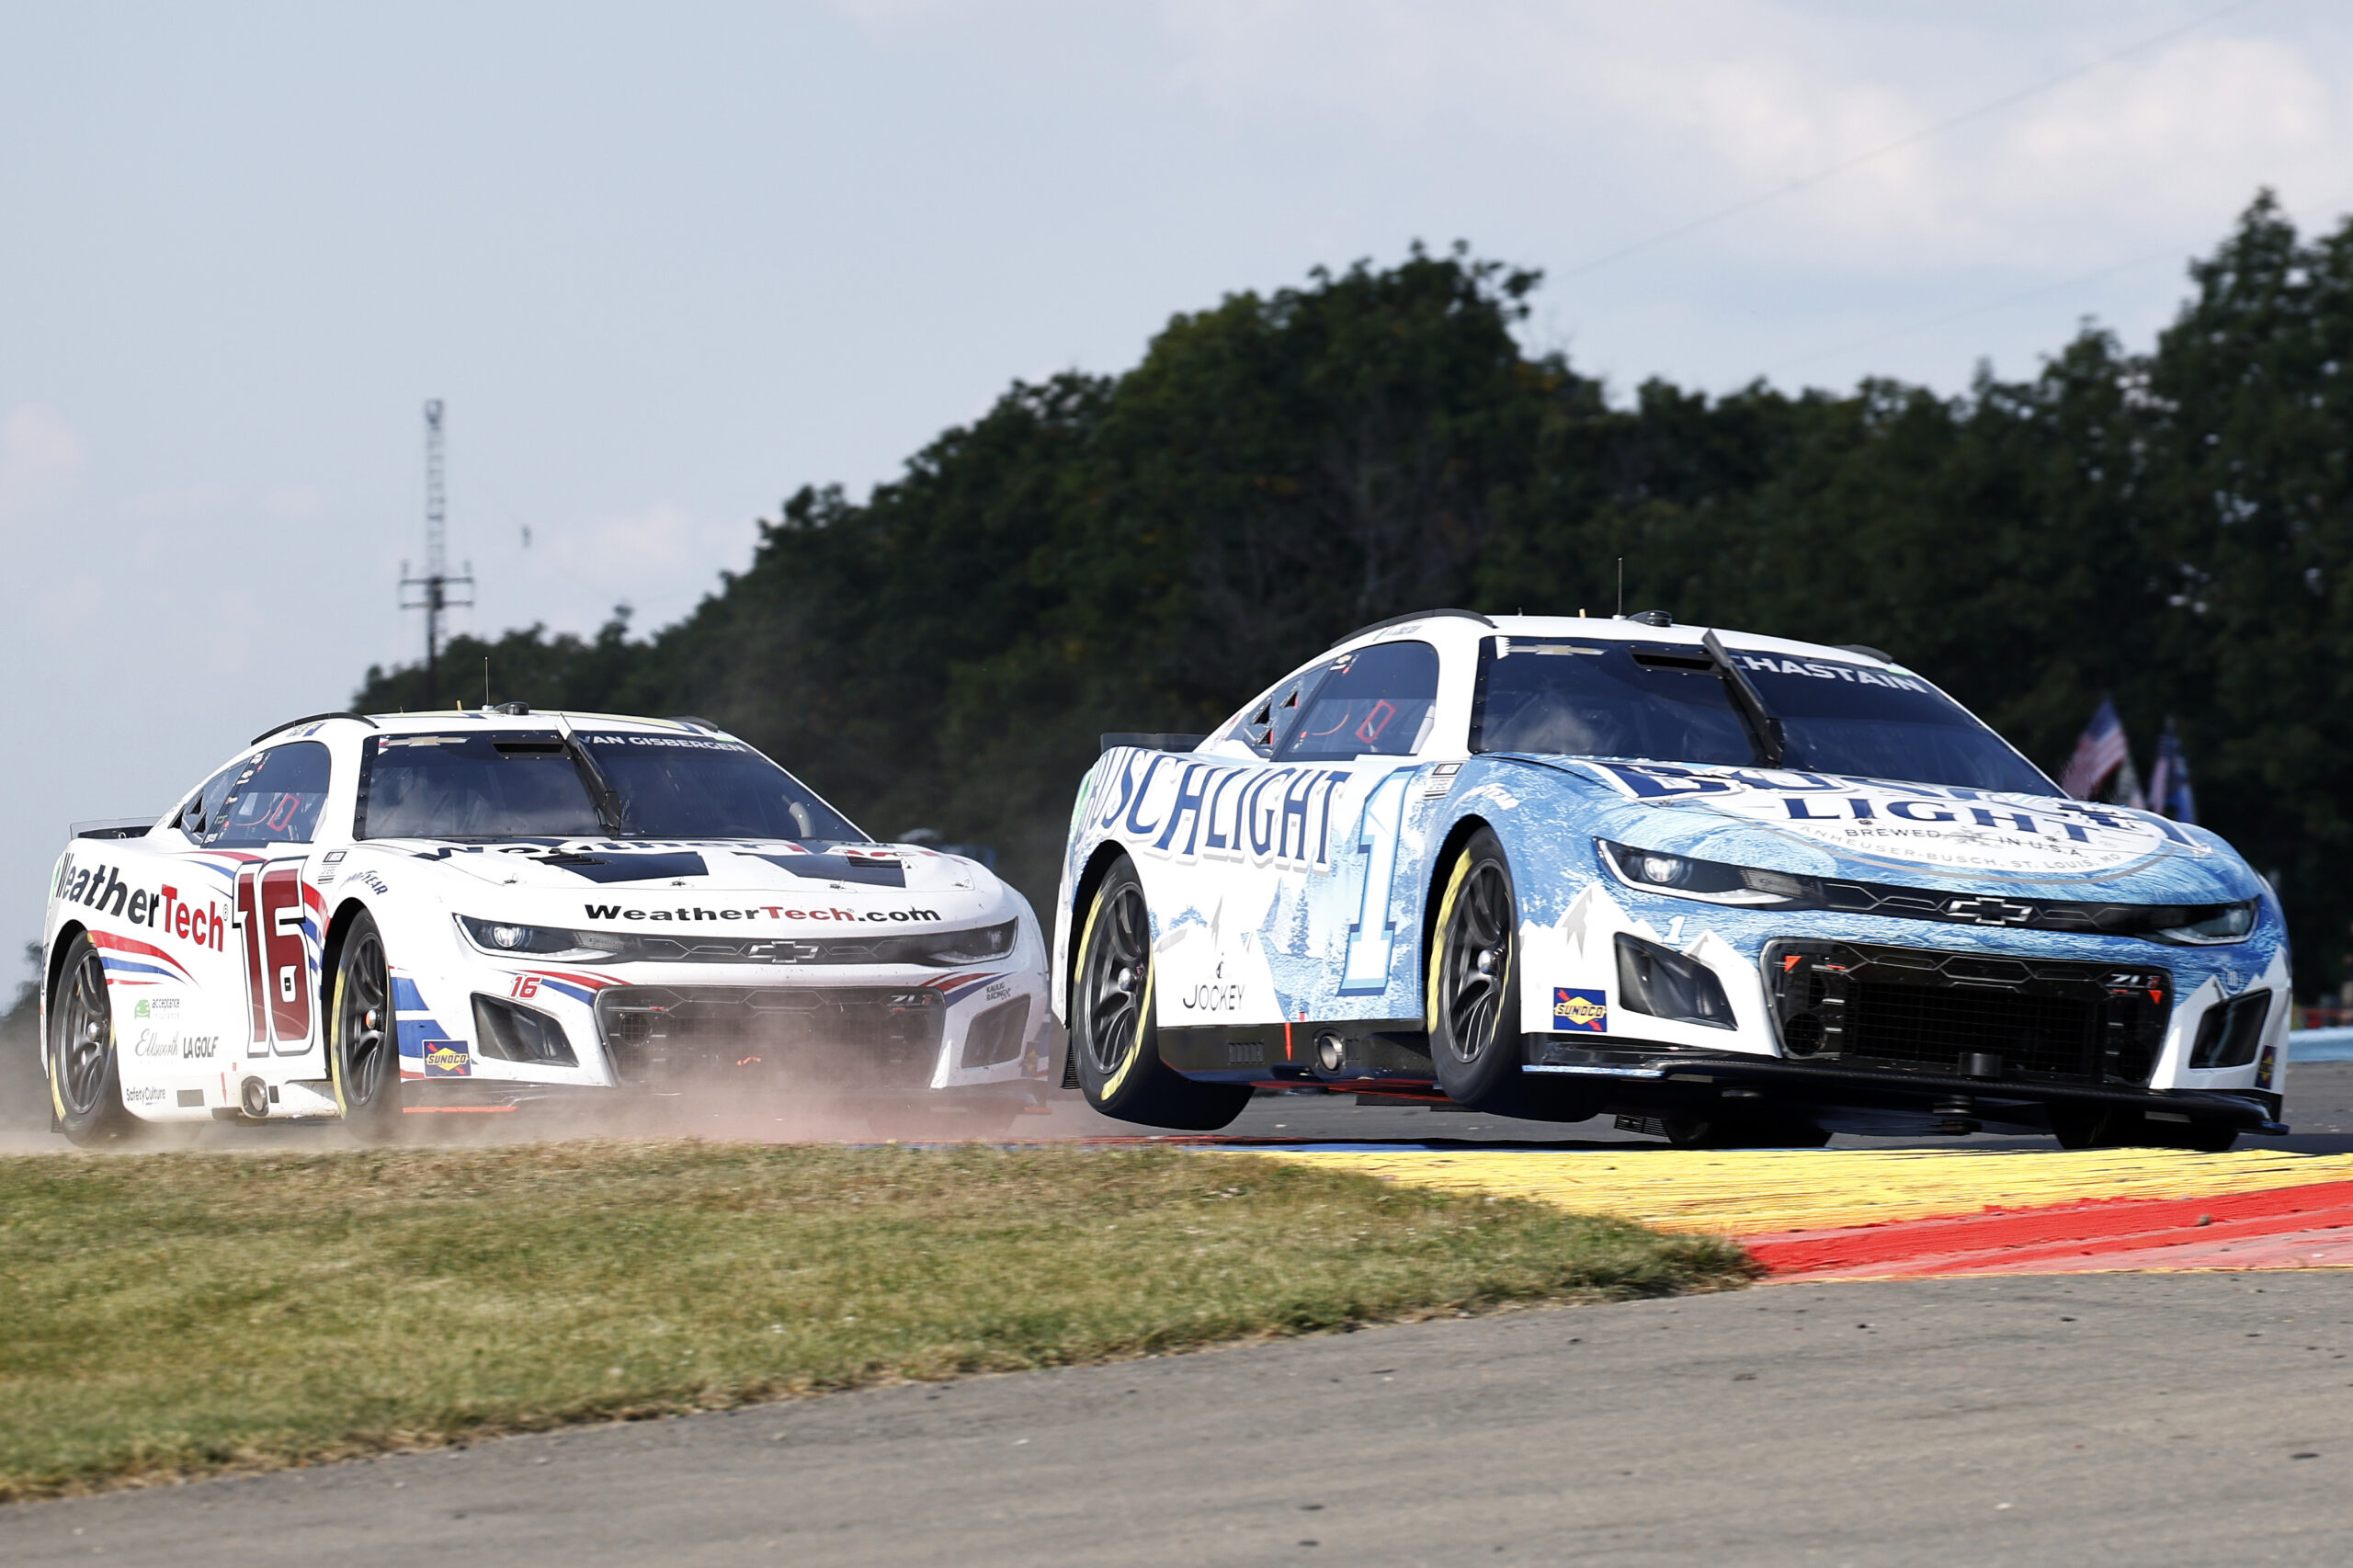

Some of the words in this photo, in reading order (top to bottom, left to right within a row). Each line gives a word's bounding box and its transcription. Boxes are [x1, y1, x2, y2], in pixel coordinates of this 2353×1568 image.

[1730, 655, 1929, 694] CHASTAIN
[577, 735, 626, 744] VAN
[629, 736, 747, 753] GISBERGEN
[1779, 798, 2101, 843] LIGHT
[1845, 829, 1941, 838] BREWED
[1998, 836, 2021, 846] IN
[2011, 860, 2040, 869] ST.
[2100, 853, 2121, 864] MO
[1336, 764, 1424, 997] 1
[55, 852, 224, 953] WeatherTech
[585, 903, 941, 922] WeatherTech.com
[1663, 915, 1687, 945] 1
[232, 855, 315, 1059] 16
[510, 975, 543, 999] 16
[2110, 973, 2161, 988] ZL1
[891, 994, 934, 1006] ZL1
[1182, 984, 1245, 1012] JOCKEY
[1556, 1004, 1605, 1017] SUNOCO
[183, 1037, 194, 1059] LA
[194, 1036, 219, 1059] GOLF
[427, 1054, 468, 1064] SUNOCO
